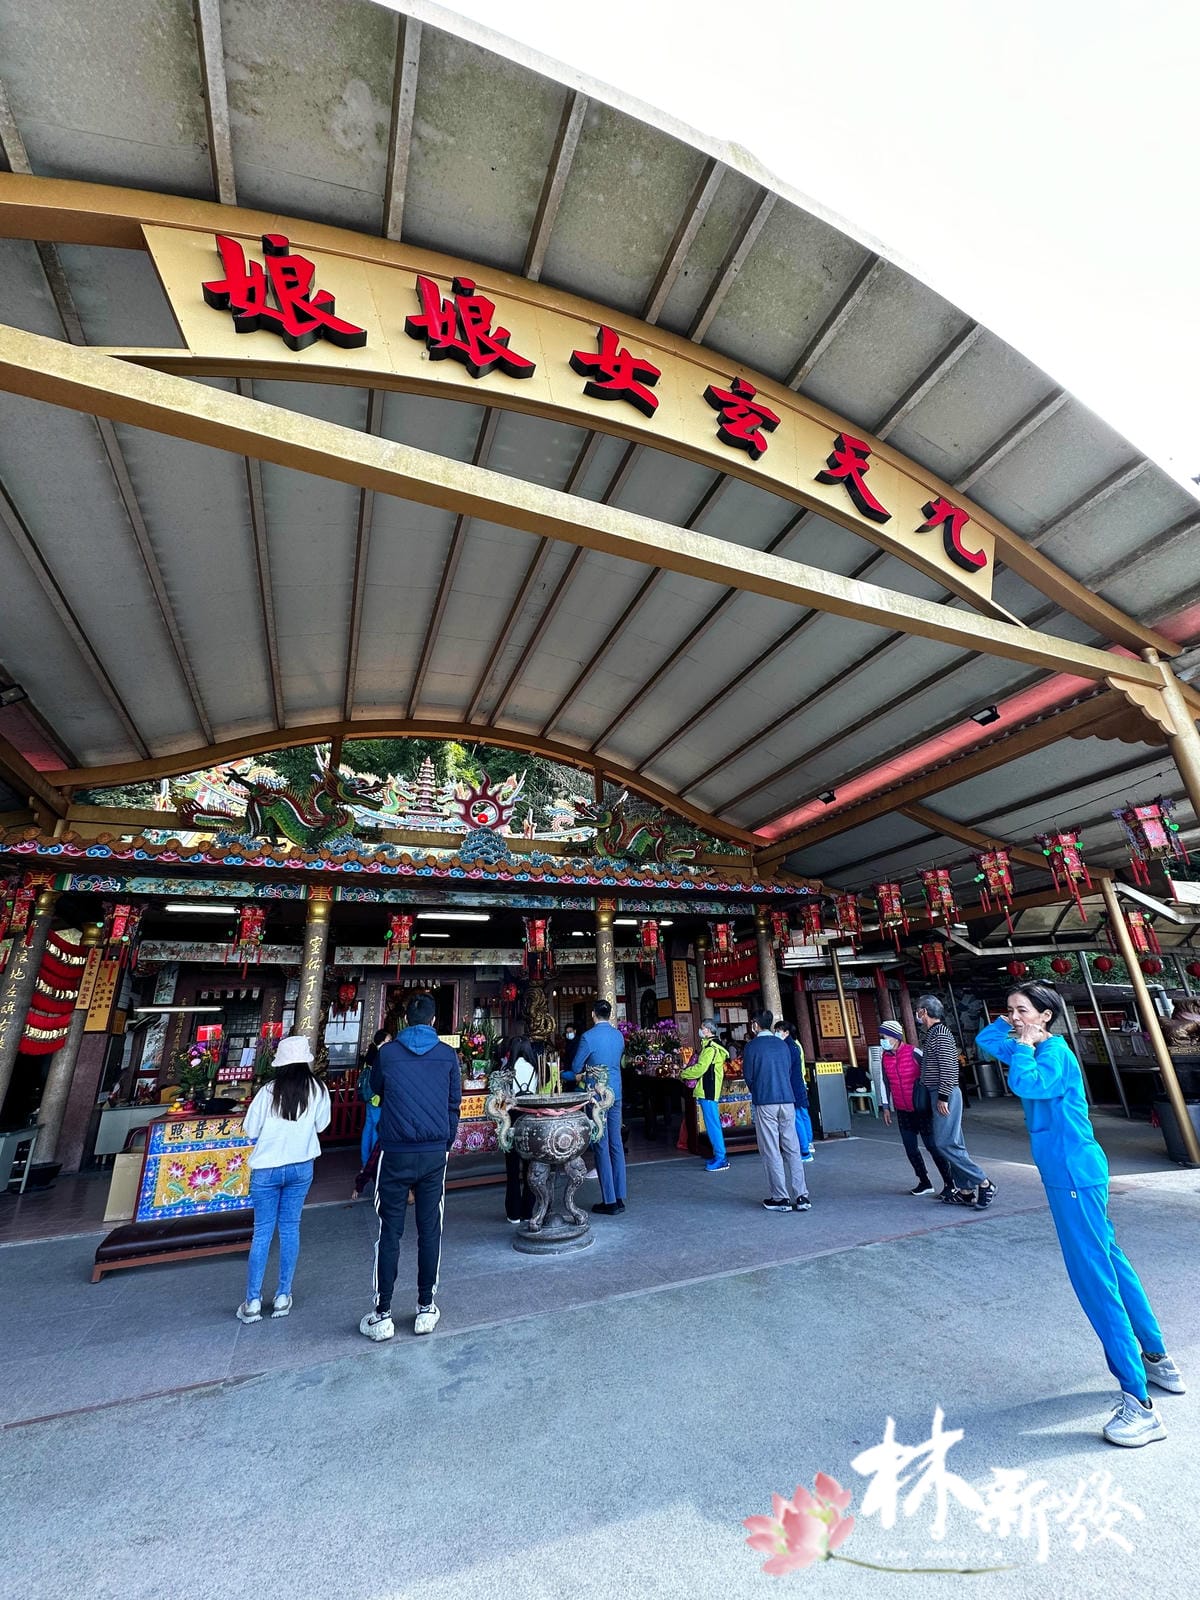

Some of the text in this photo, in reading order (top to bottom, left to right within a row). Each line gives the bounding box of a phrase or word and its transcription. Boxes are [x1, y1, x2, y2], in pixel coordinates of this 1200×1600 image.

[202, 232, 988, 573] 九天玄女娘娘
[168, 1118, 244, 1141] 光普照
